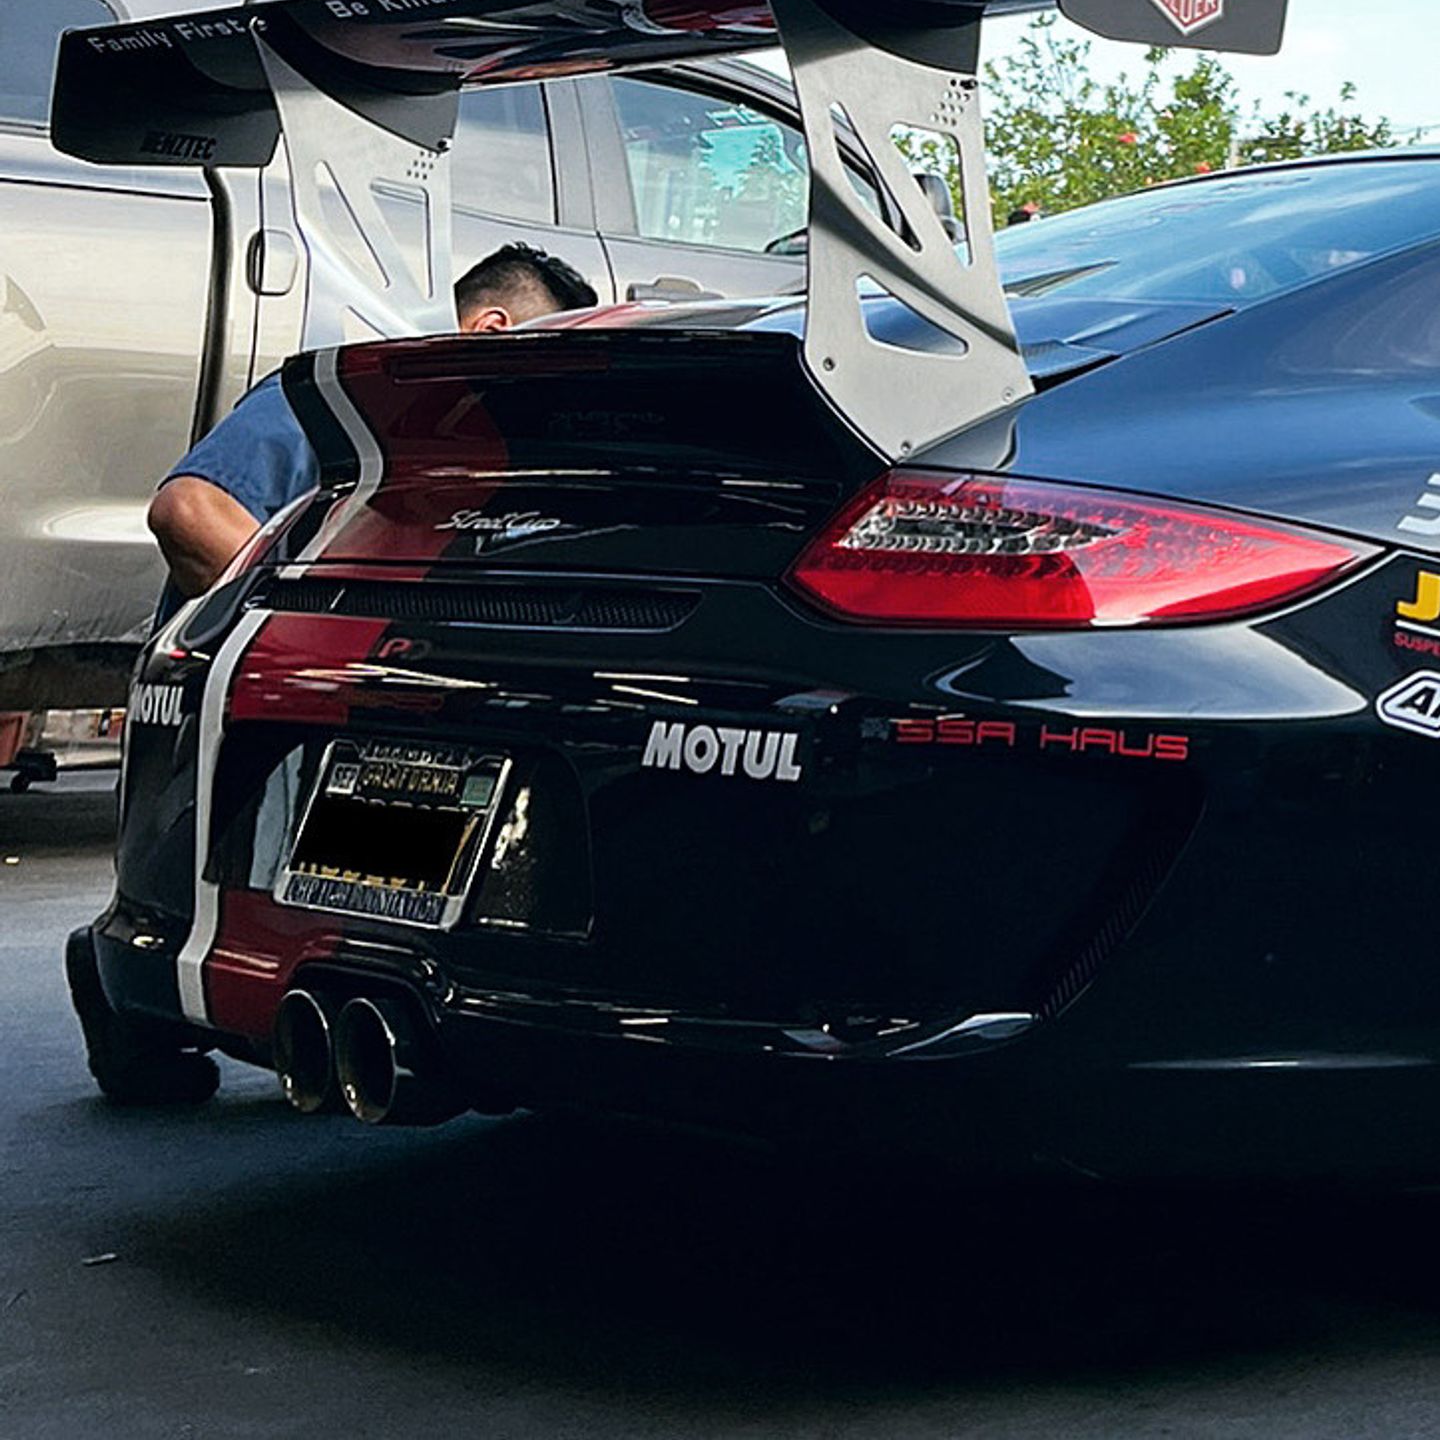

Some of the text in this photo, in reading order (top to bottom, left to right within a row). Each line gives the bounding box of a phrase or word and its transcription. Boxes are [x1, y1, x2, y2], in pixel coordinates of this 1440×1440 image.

[324, 0, 370, 18] Be
[87, 29, 173, 53] Family
[129, 683, 184, 725] MOTUL
[641, 720, 802, 782] MOTUL
[896, 719, 1016, 746] SSA
[1040, 723, 1189, 760] HAUS
[358, 762, 460, 799] CALIFORNIA
